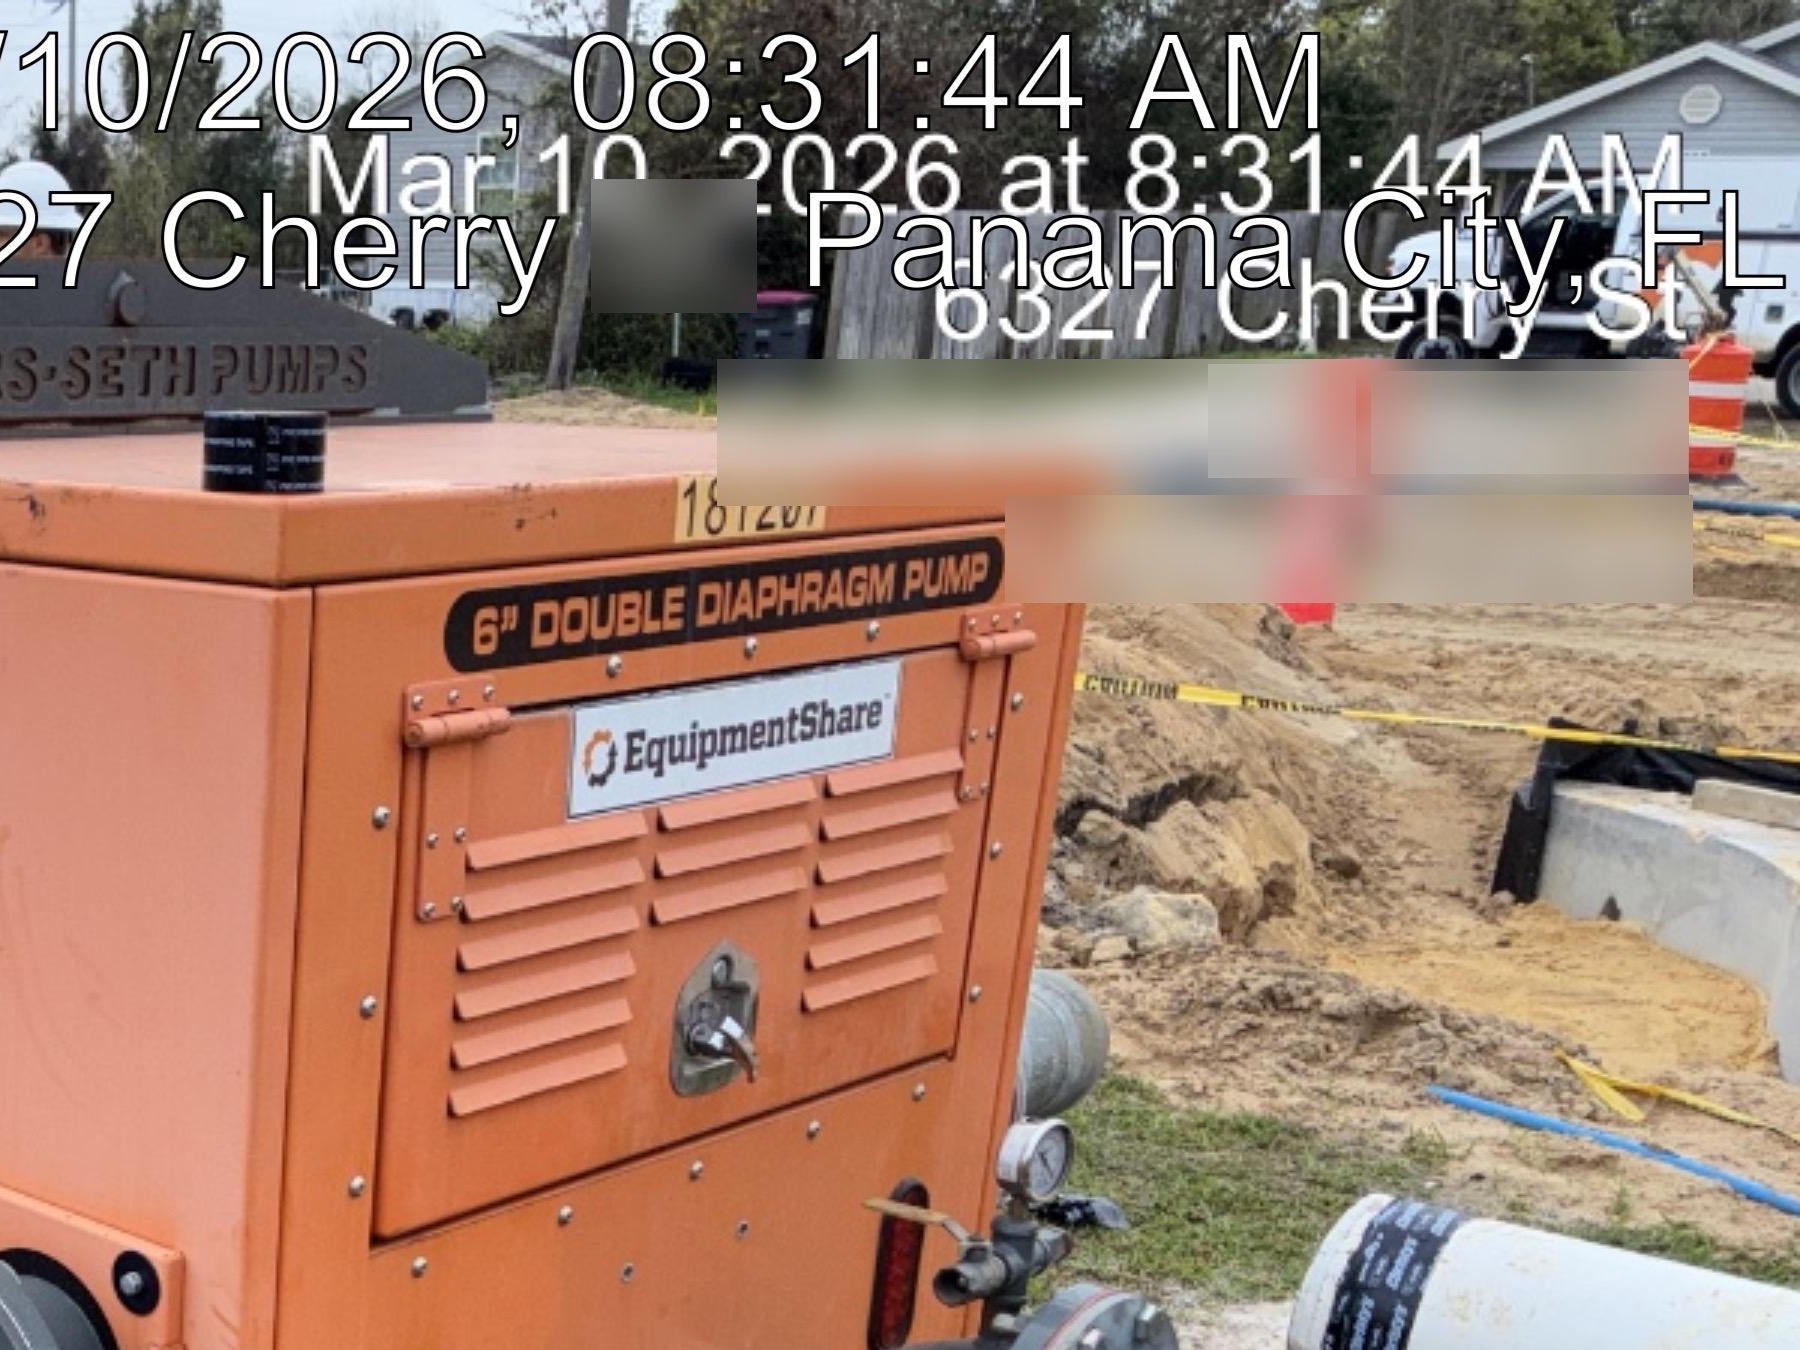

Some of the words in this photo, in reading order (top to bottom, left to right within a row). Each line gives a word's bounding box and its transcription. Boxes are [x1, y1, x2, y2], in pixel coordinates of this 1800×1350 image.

[210, 343, 368, 396] PUMPS
[531, 586, 687, 648] DOUBLE
[695, 561, 898, 627] DIAPHRAGM
[903, 551, 990, 600] PUMP
[623, 699, 883, 777] EquipmentShare
